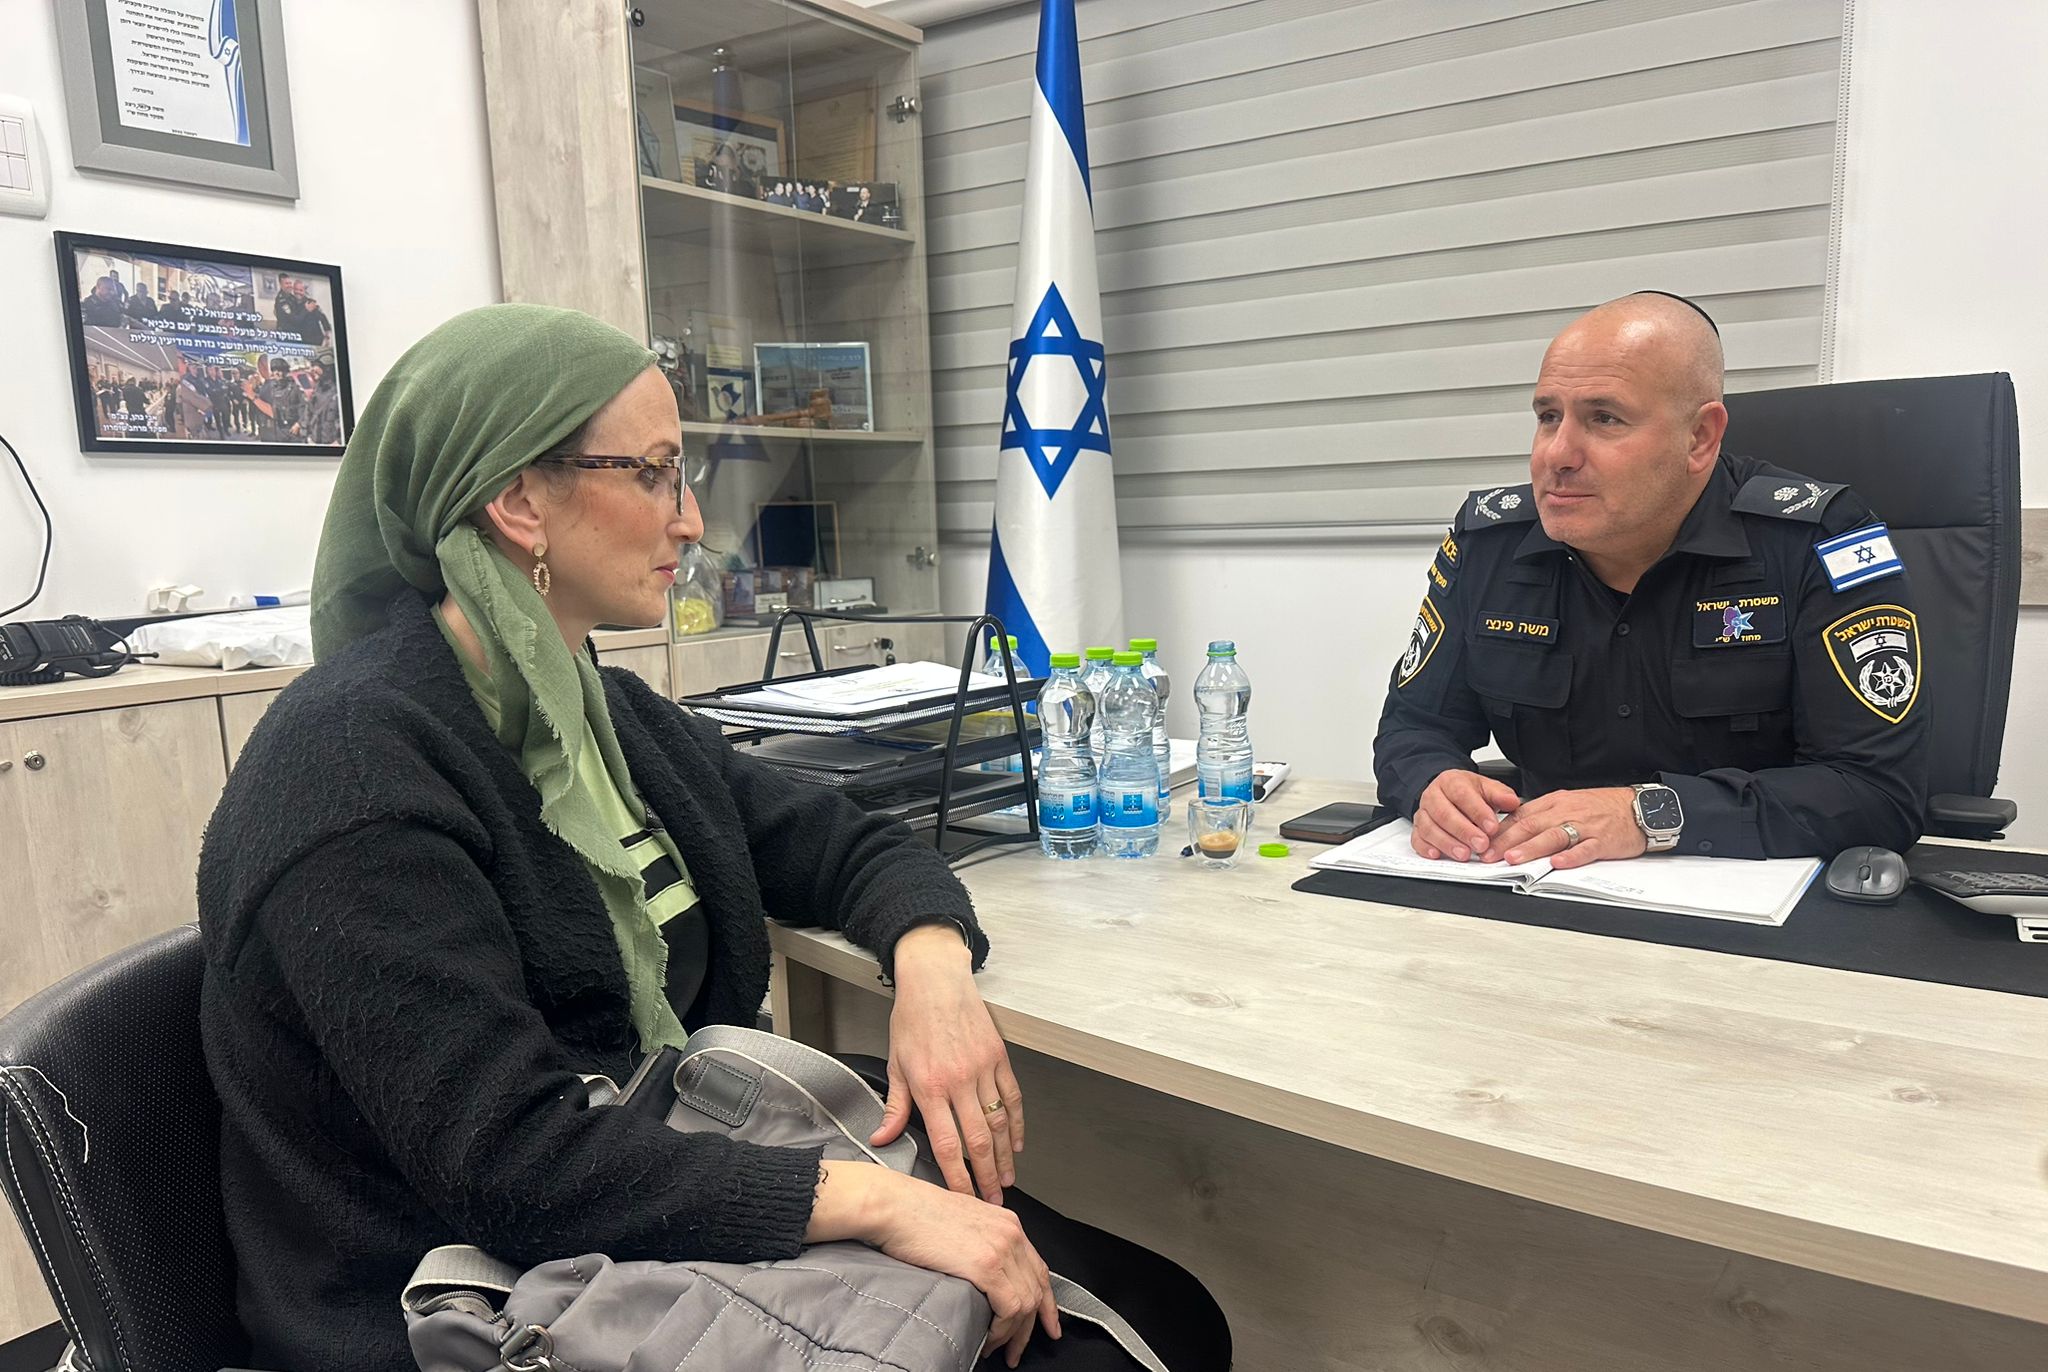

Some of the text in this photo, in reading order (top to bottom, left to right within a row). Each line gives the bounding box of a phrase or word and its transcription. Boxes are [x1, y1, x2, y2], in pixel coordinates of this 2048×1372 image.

[204, 308, 234, 319] שמואל
[198, 324, 228, 334] במבצע
[230, 326, 256, 336] פועלך
[256, 328, 268, 338] על
[270, 332, 302, 341] בהוקרה
[130, 334, 316, 356] ותרומתך לביטחון תושבי גזרת מודיעין עילית
[208, 356, 224, 364] כוח
[1696, 600, 1730, 612] ישראל
[1518, 622, 1550, 637] משה
[1834, 618, 1875, 642] ישראל
[1741, 634, 1762, 642] מחוז
